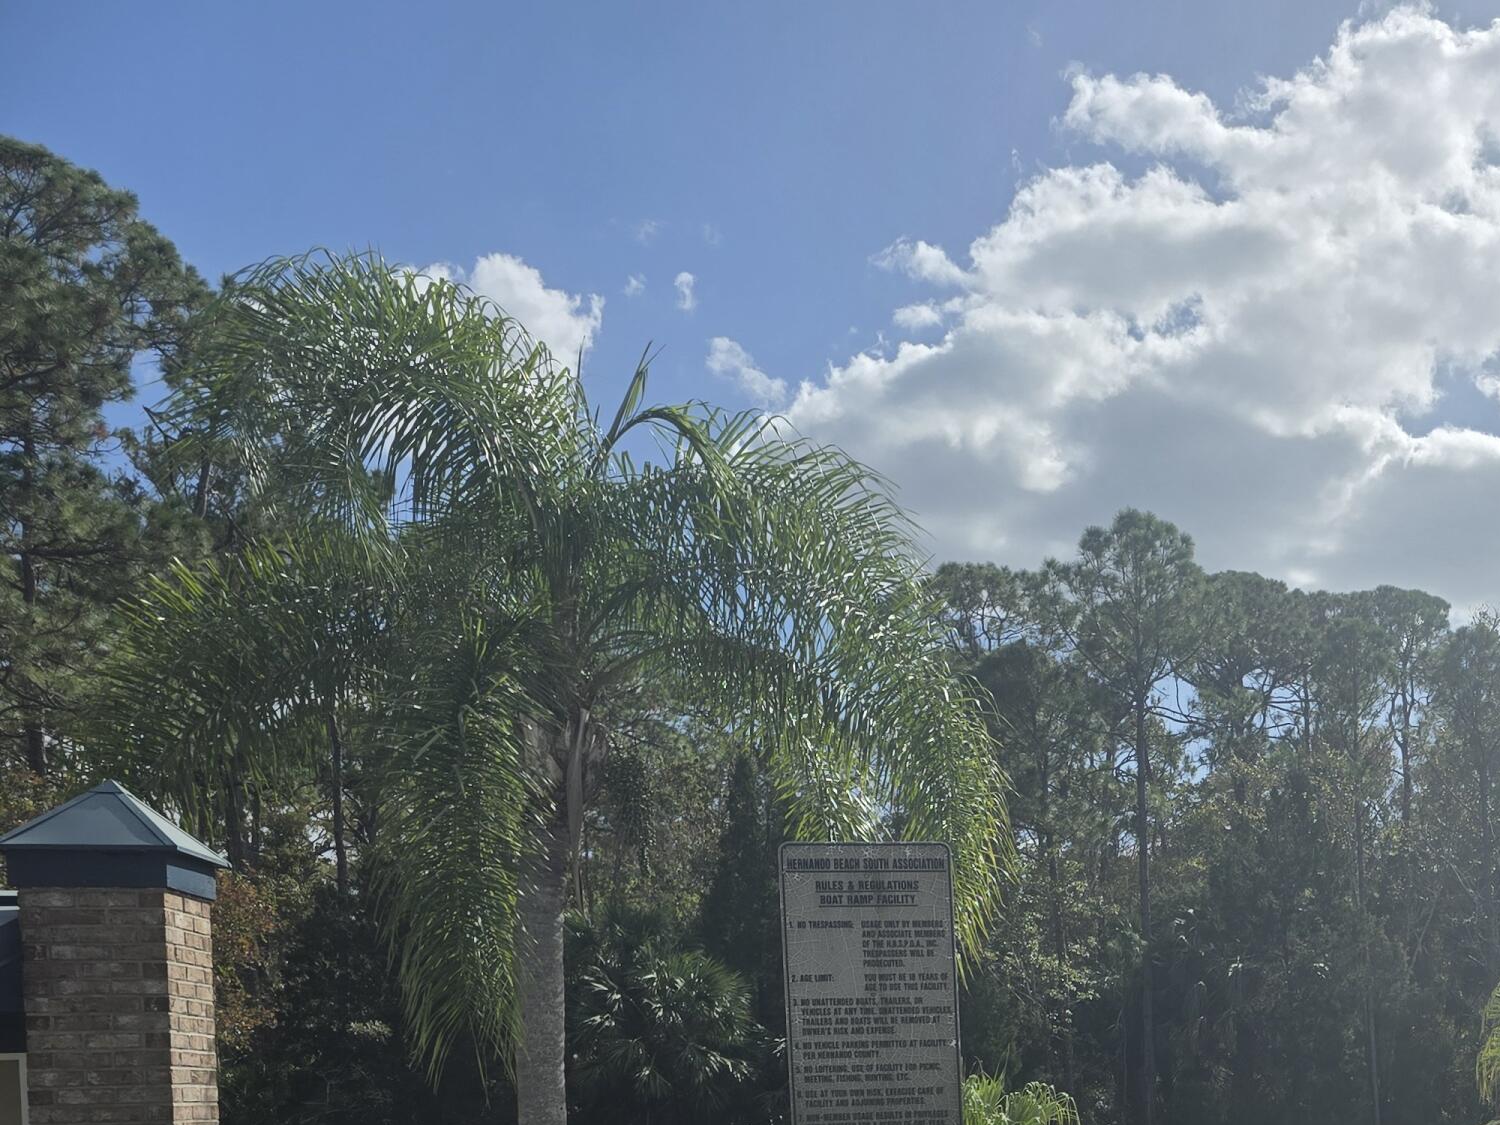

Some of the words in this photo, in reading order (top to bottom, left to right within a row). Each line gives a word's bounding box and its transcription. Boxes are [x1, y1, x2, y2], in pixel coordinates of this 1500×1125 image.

[787, 859, 830, 869] HERNANDO
[834, 859, 860, 869] BEACH
[863, 858, 889, 869] SOUTH
[893, 858, 944, 869] ASSOCIATION
[816, 881, 843, 890] RULES
[848, 881, 854, 890] &
[859, 881, 919, 890] REGULATIONS
[820, 895, 843, 904] BOAT
[848, 895, 873, 904] RAMP
[877, 895, 916, 904] FACILITY
[815, 974, 834, 982] LIMIT:
